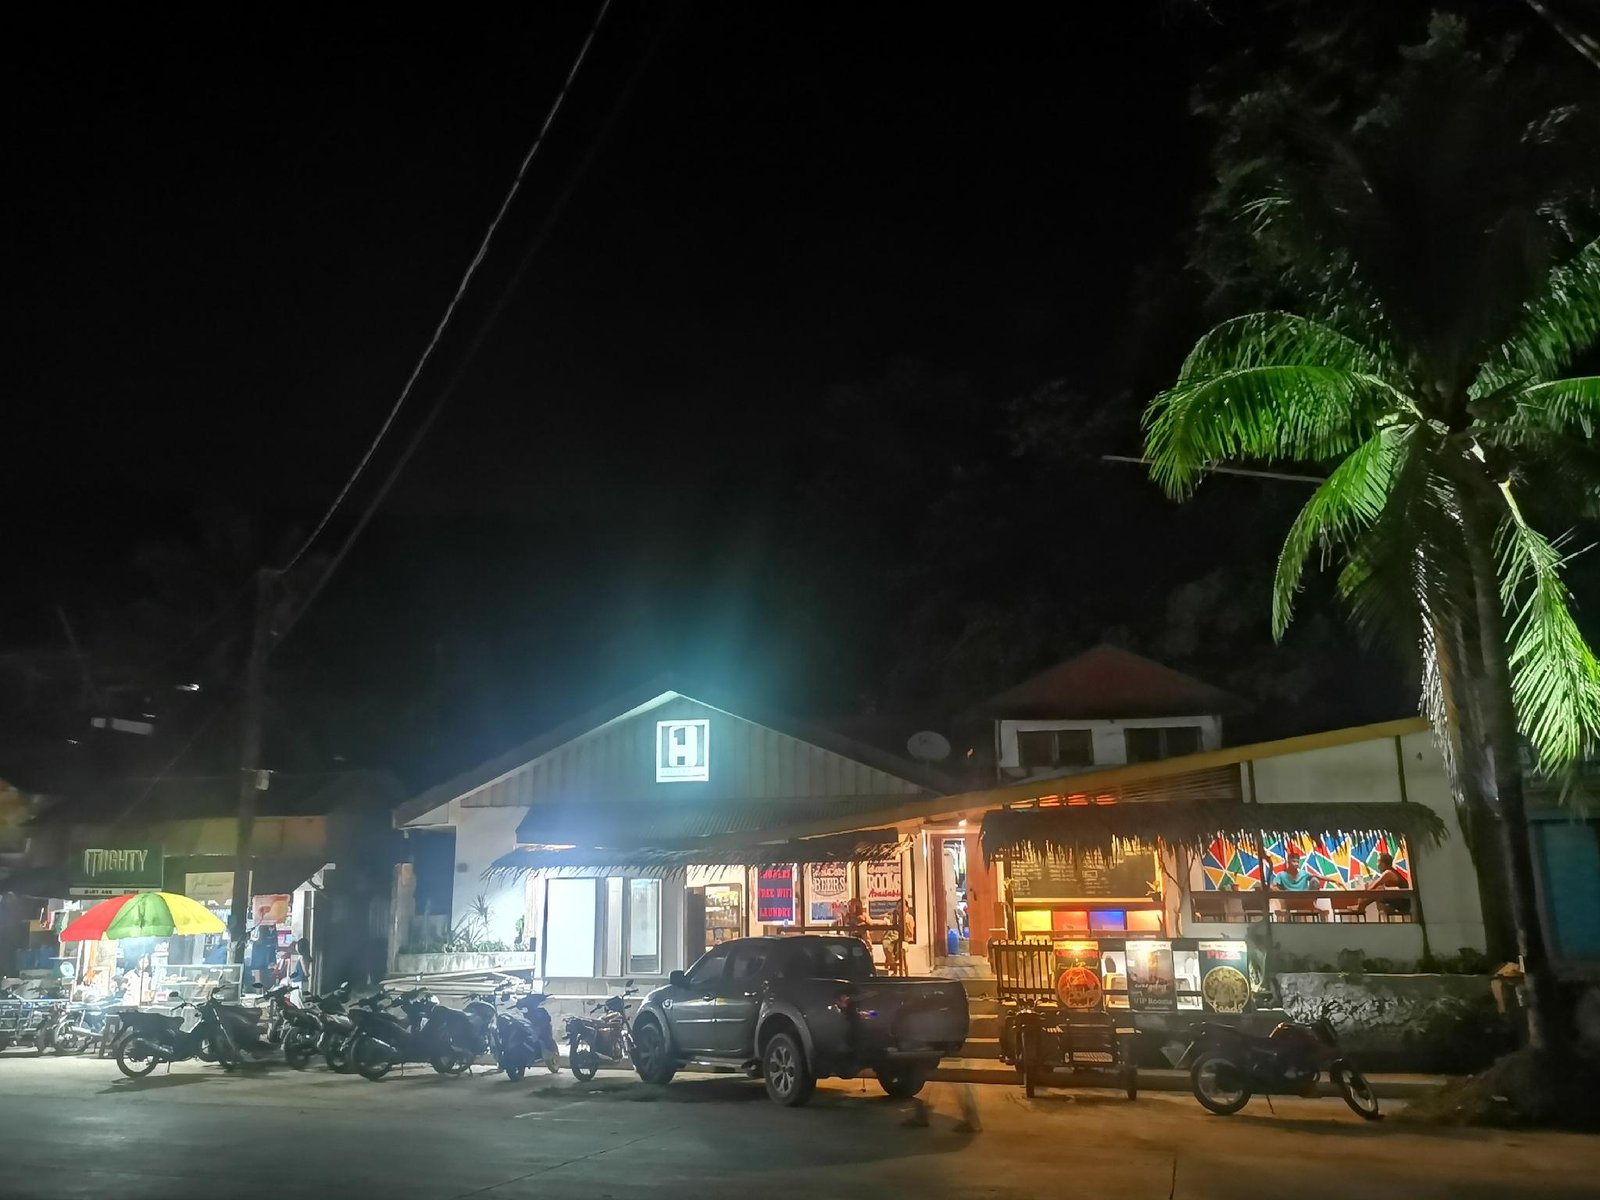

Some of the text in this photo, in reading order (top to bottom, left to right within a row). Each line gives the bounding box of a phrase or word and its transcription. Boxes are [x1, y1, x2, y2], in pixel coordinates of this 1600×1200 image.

[84, 849, 148, 877] MIGHTY
[813, 877, 847, 892] BEERS
[759, 907, 791, 917] LAUNDRY
